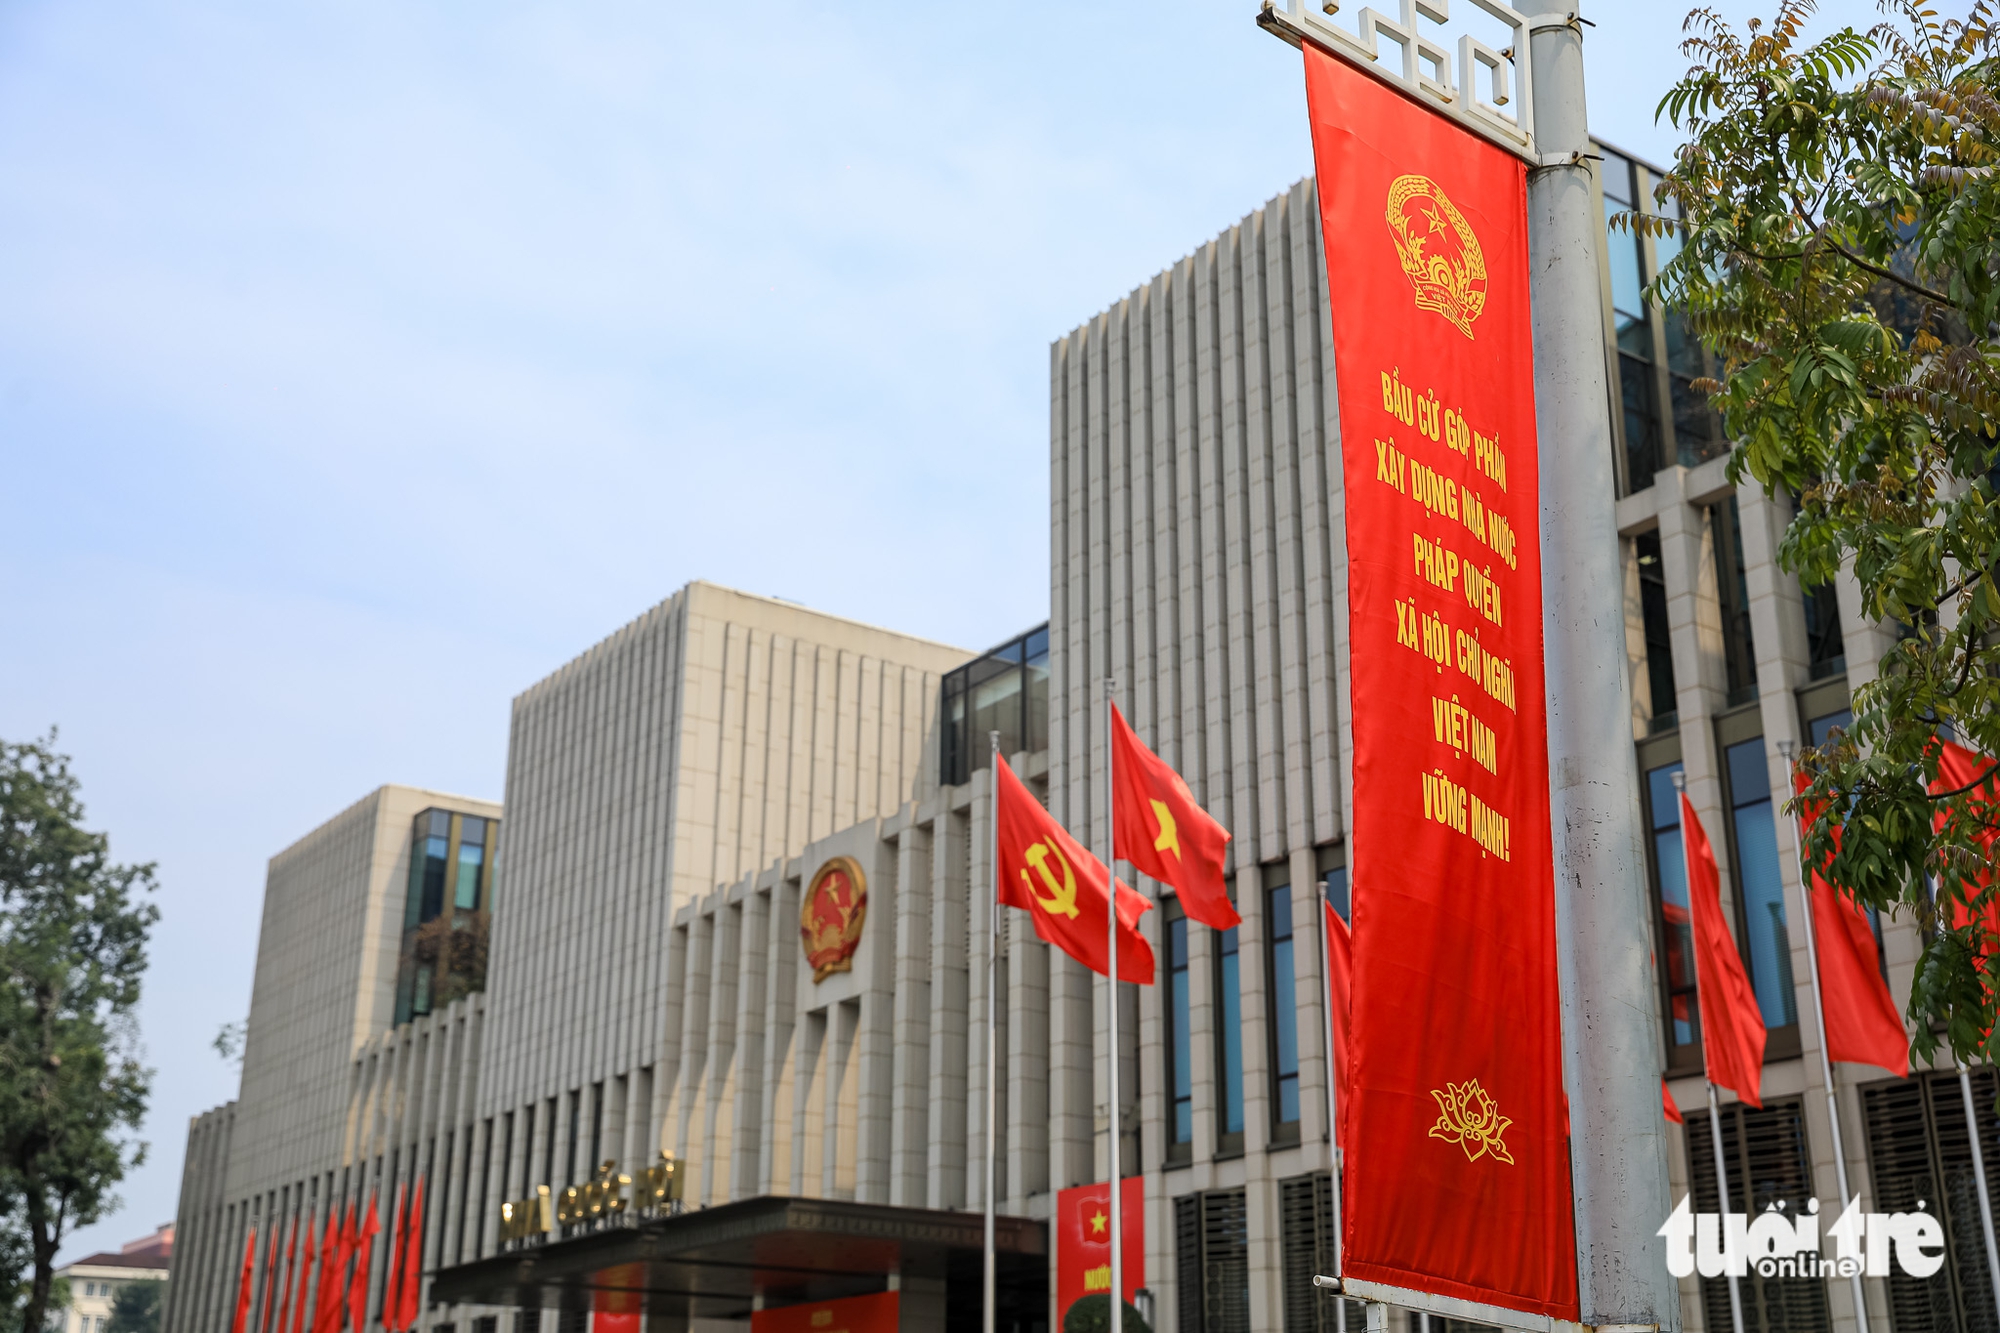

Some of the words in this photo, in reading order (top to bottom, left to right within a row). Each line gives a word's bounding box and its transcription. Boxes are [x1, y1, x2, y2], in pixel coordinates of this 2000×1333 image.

[1381, 366, 1414, 427] BẦU
[1417, 388, 1441, 442] CỬ
[1444, 407, 1471, 461] GÓP
[1473, 432, 1507, 494] PHẦN
[1374, 436, 1406, 495] XÂY
[1410, 458, 1460, 522] DỰNG
[1488, 508, 1517, 571] NƯỚC
[1413, 532, 1459, 593] PHÁP
[1462, 558, 1502, 628] QUYỀN
[1394, 596, 1420, 652] XÃ
[1421, 610, 1451, 674] HỘI
[1456, 627, 1481, 686] CHỦ
[1432, 693, 1470, 759] VIỆT
[1471, 713, 1498, 777] NAM
[1422, 767, 1467, 835] VỮNG
[1470, 793, 1511, 863] MẠNH!
